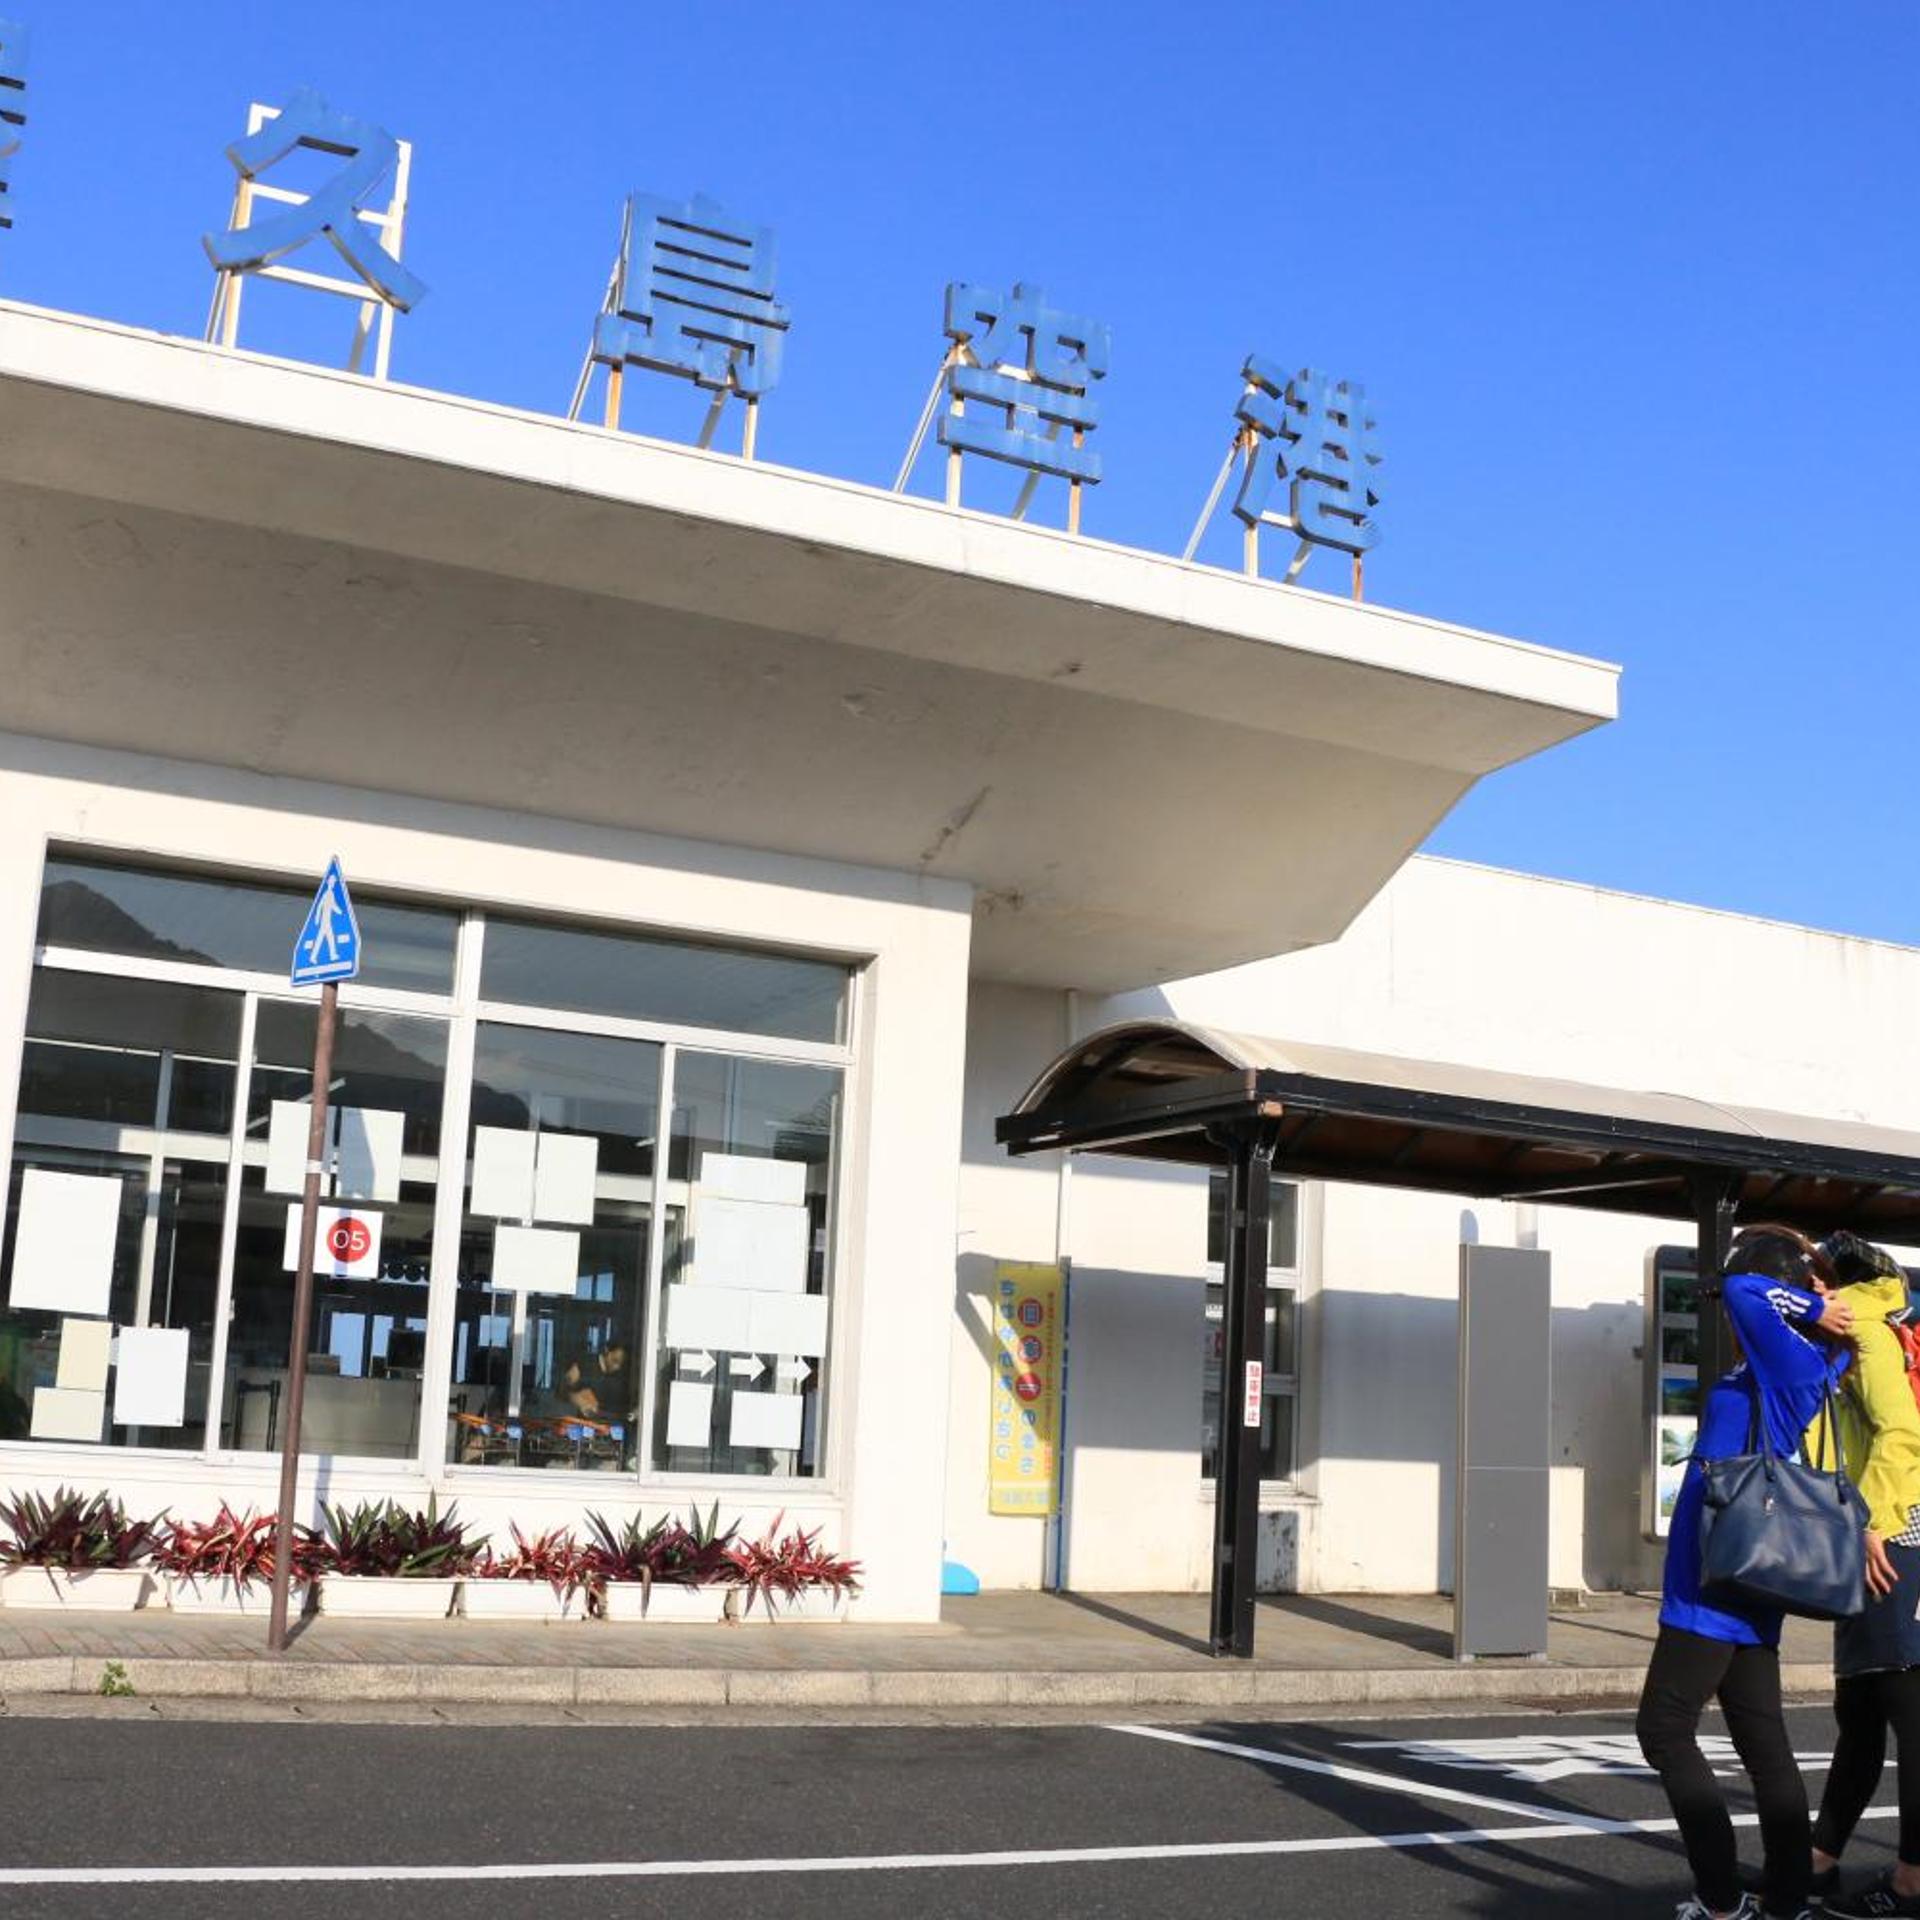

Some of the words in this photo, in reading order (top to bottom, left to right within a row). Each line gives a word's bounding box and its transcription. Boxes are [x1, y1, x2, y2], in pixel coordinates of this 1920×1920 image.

[0, 18, 1382, 553] 久島空港
[333, 1229, 366, 1252] 05
